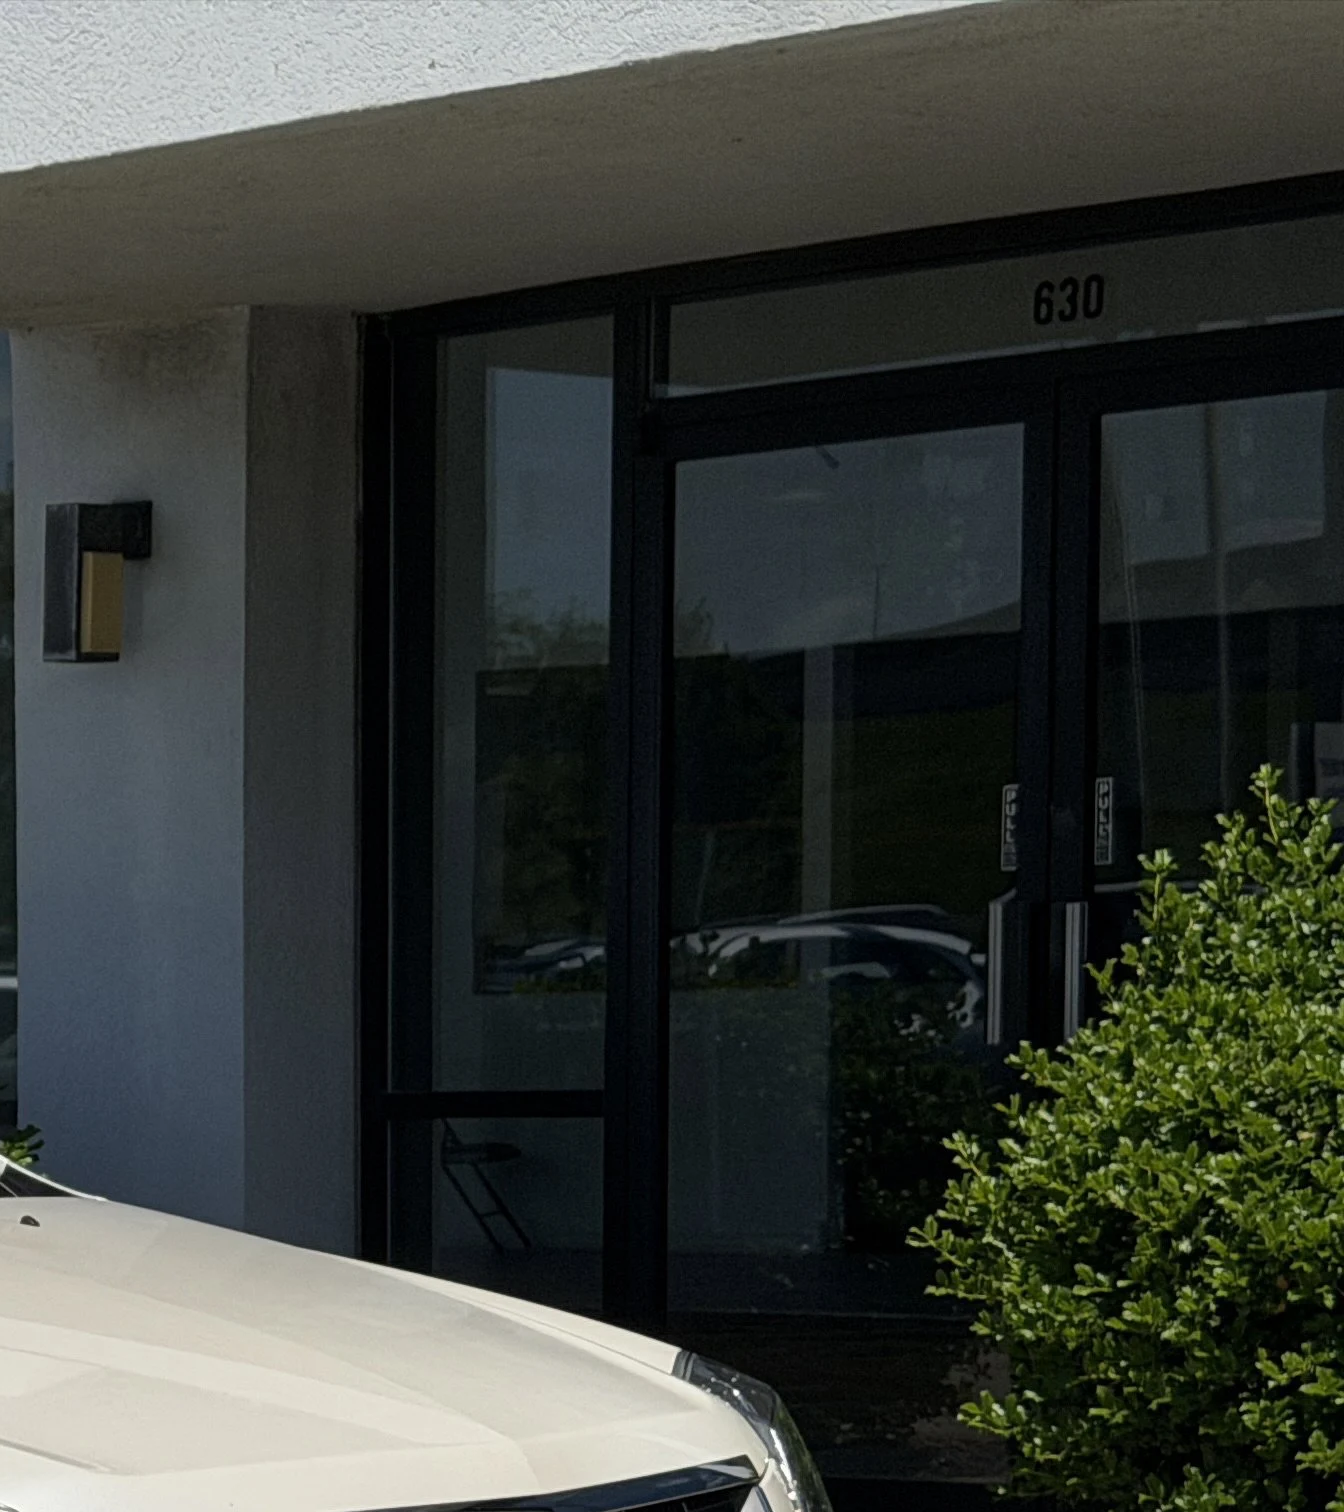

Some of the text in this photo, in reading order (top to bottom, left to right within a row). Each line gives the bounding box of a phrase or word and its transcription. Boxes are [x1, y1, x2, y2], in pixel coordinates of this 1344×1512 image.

[1032, 272, 1105, 326] 630
[1006, 790, 1017, 842] PULL
[1098, 782, 1109, 836] PULL
